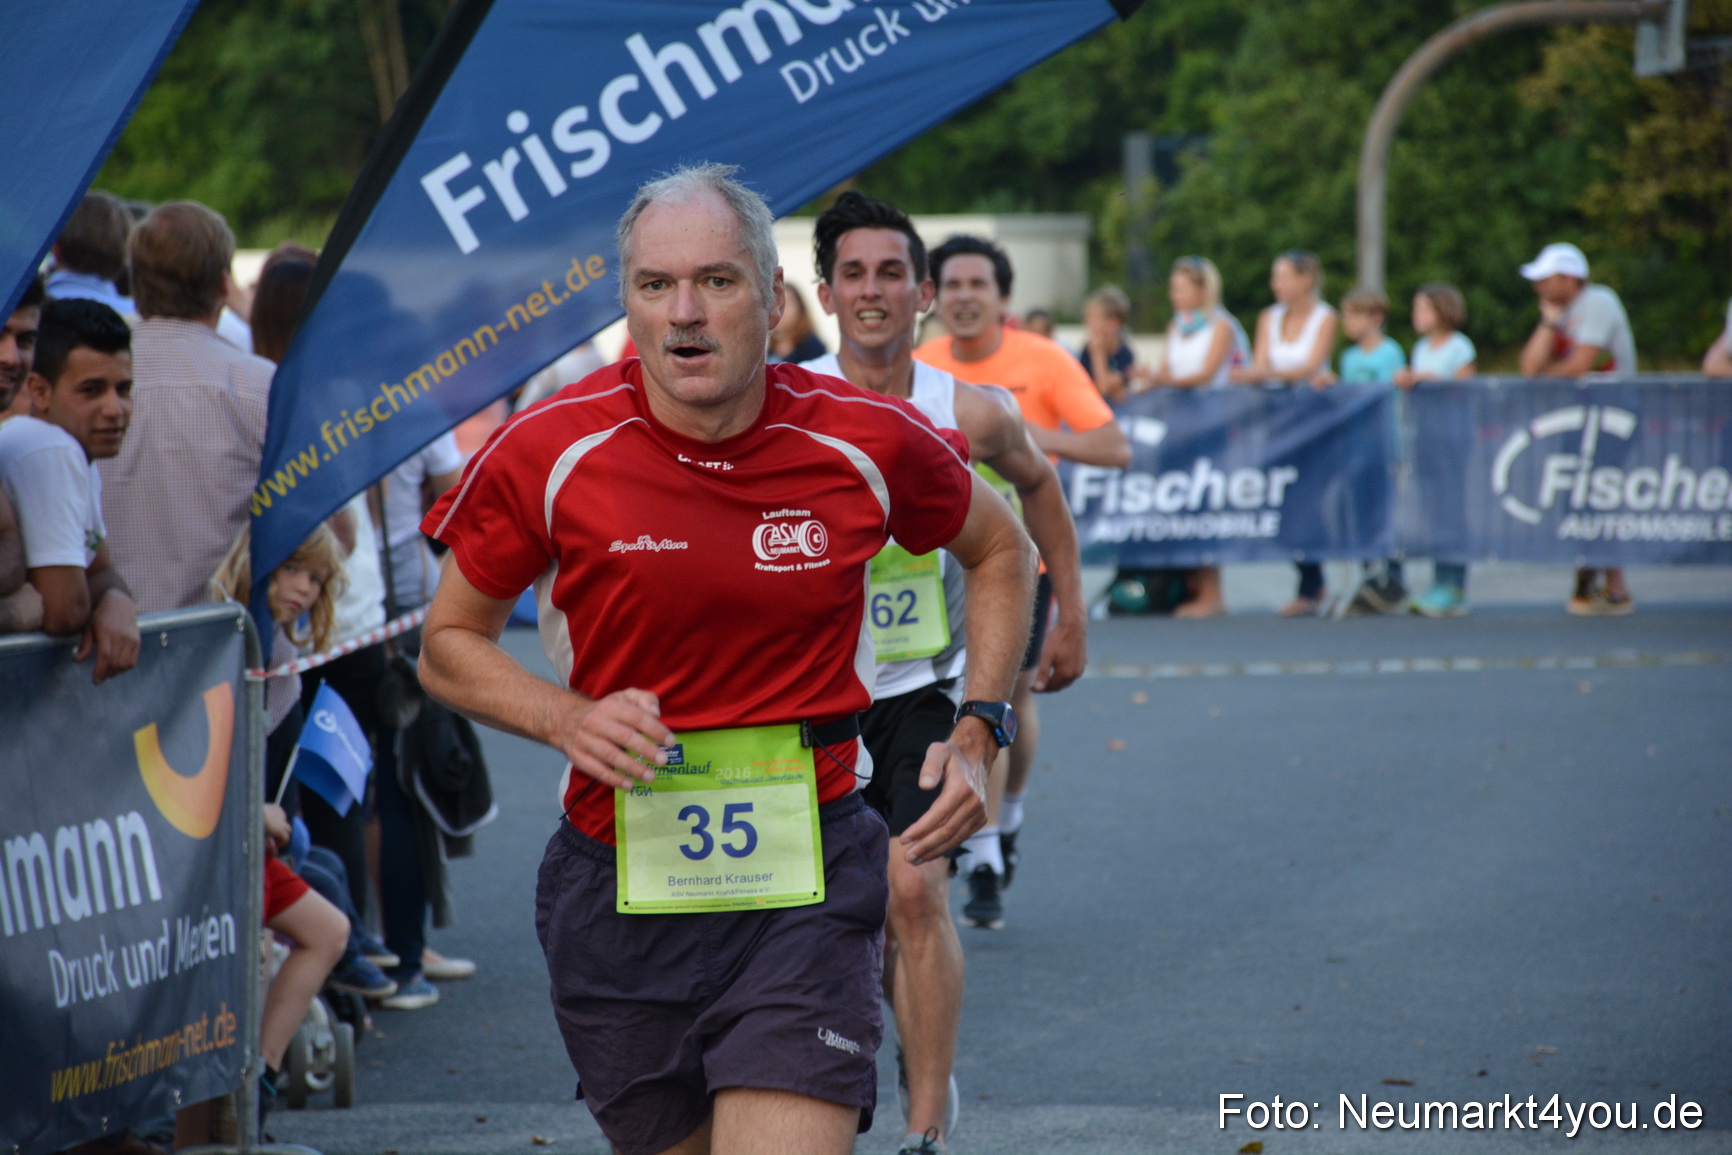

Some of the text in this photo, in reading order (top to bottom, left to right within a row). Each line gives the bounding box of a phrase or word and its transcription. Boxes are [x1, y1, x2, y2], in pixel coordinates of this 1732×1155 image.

[780, 7, 911, 104] Druck
[1072, 457, 1298, 515] Fischer
[1539, 453, 1732, 511] Fische
[762, 509, 811, 520] Laufteam
[1089, 511, 1283, 543] AUTOMOBILE
[771, 523, 800, 546] ASV
[754, 558, 831, 573] Kraftsport & Fitness
[870, 589, 919, 630] 62
[715, 767, 752, 780] 2016
[677, 802, 758, 861] 35
[0, 811, 162, 937] mann
[667, 872, 774, 887] Bernhard Krauser
[686, 890, 715, 898] Neumarkt
[48, 934, 120, 1009] Druck
[121, 919, 170, 990] und
